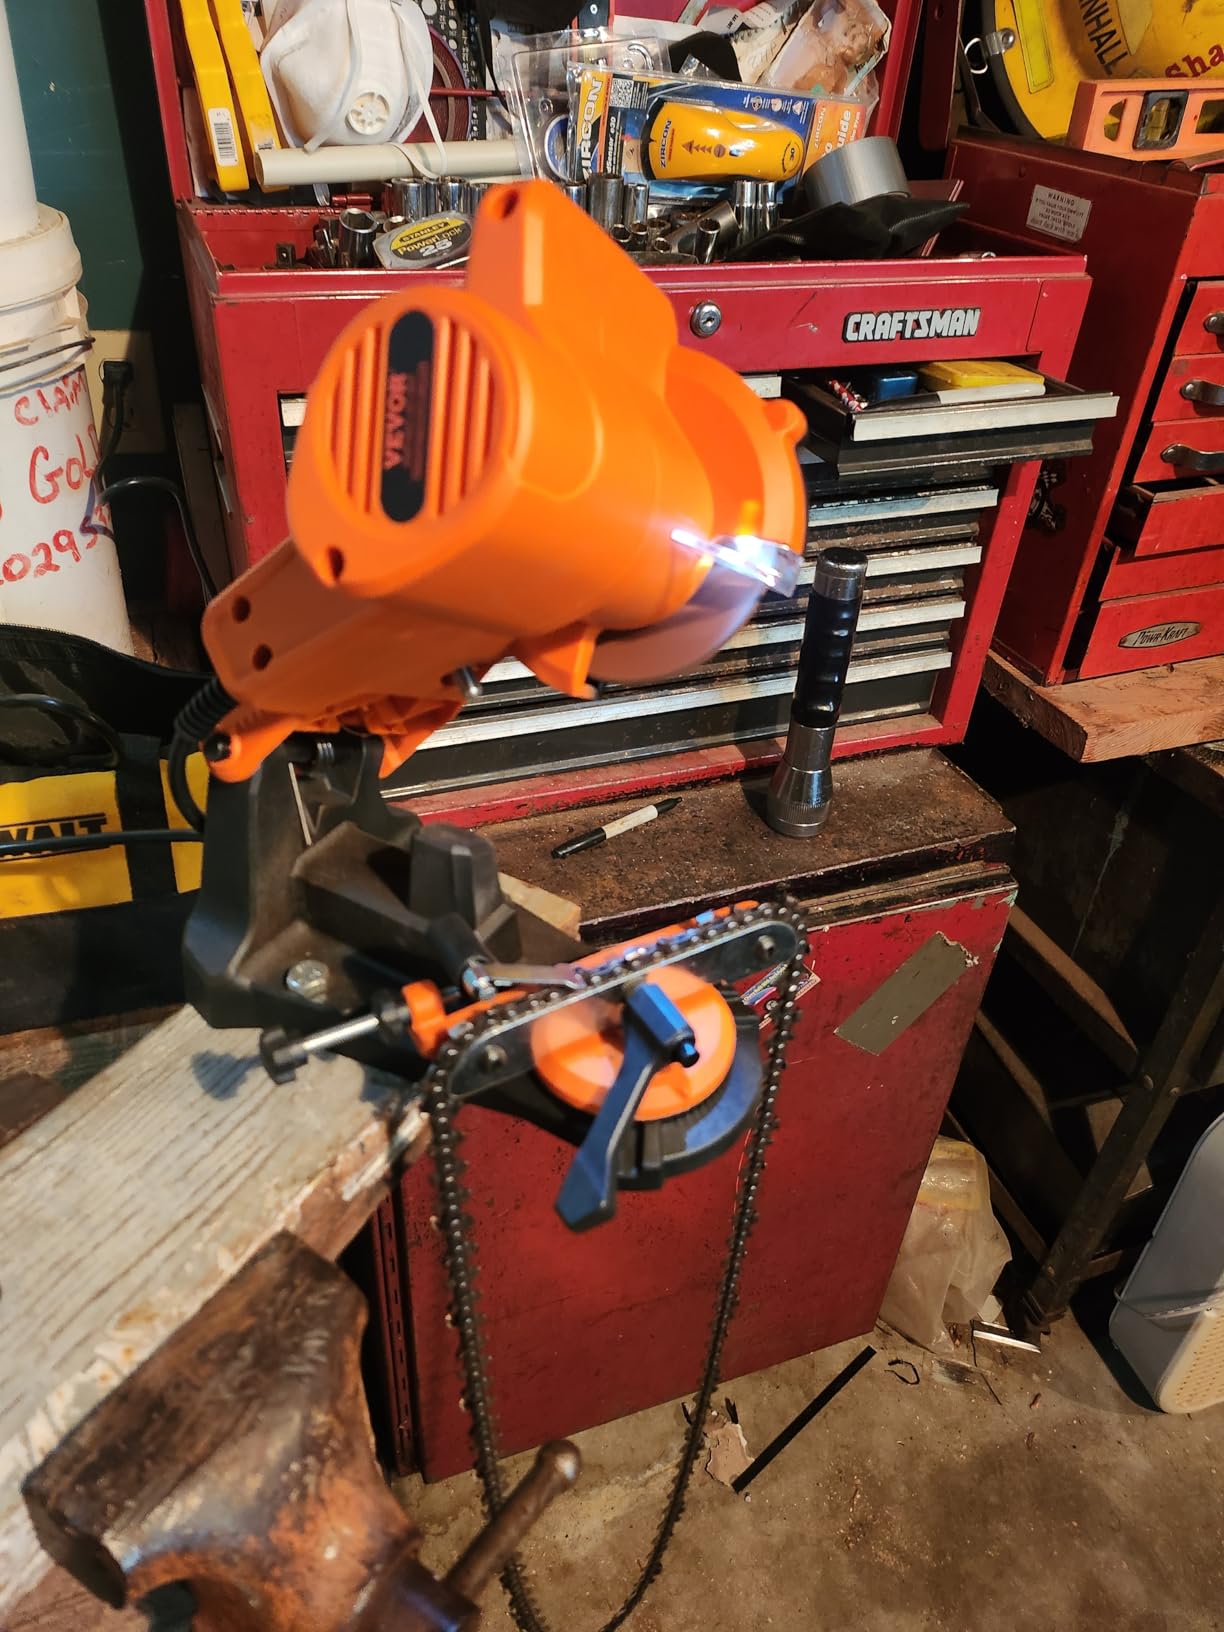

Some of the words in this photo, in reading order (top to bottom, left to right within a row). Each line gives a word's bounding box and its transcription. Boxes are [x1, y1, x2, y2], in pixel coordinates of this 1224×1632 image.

[660, 119, 672, 169] ZIRCON
[401, 222, 446, 241] STANLEY
[842, 307, 981, 343] CRAFTSMAN
[384, 372, 407, 470] VEVOR
